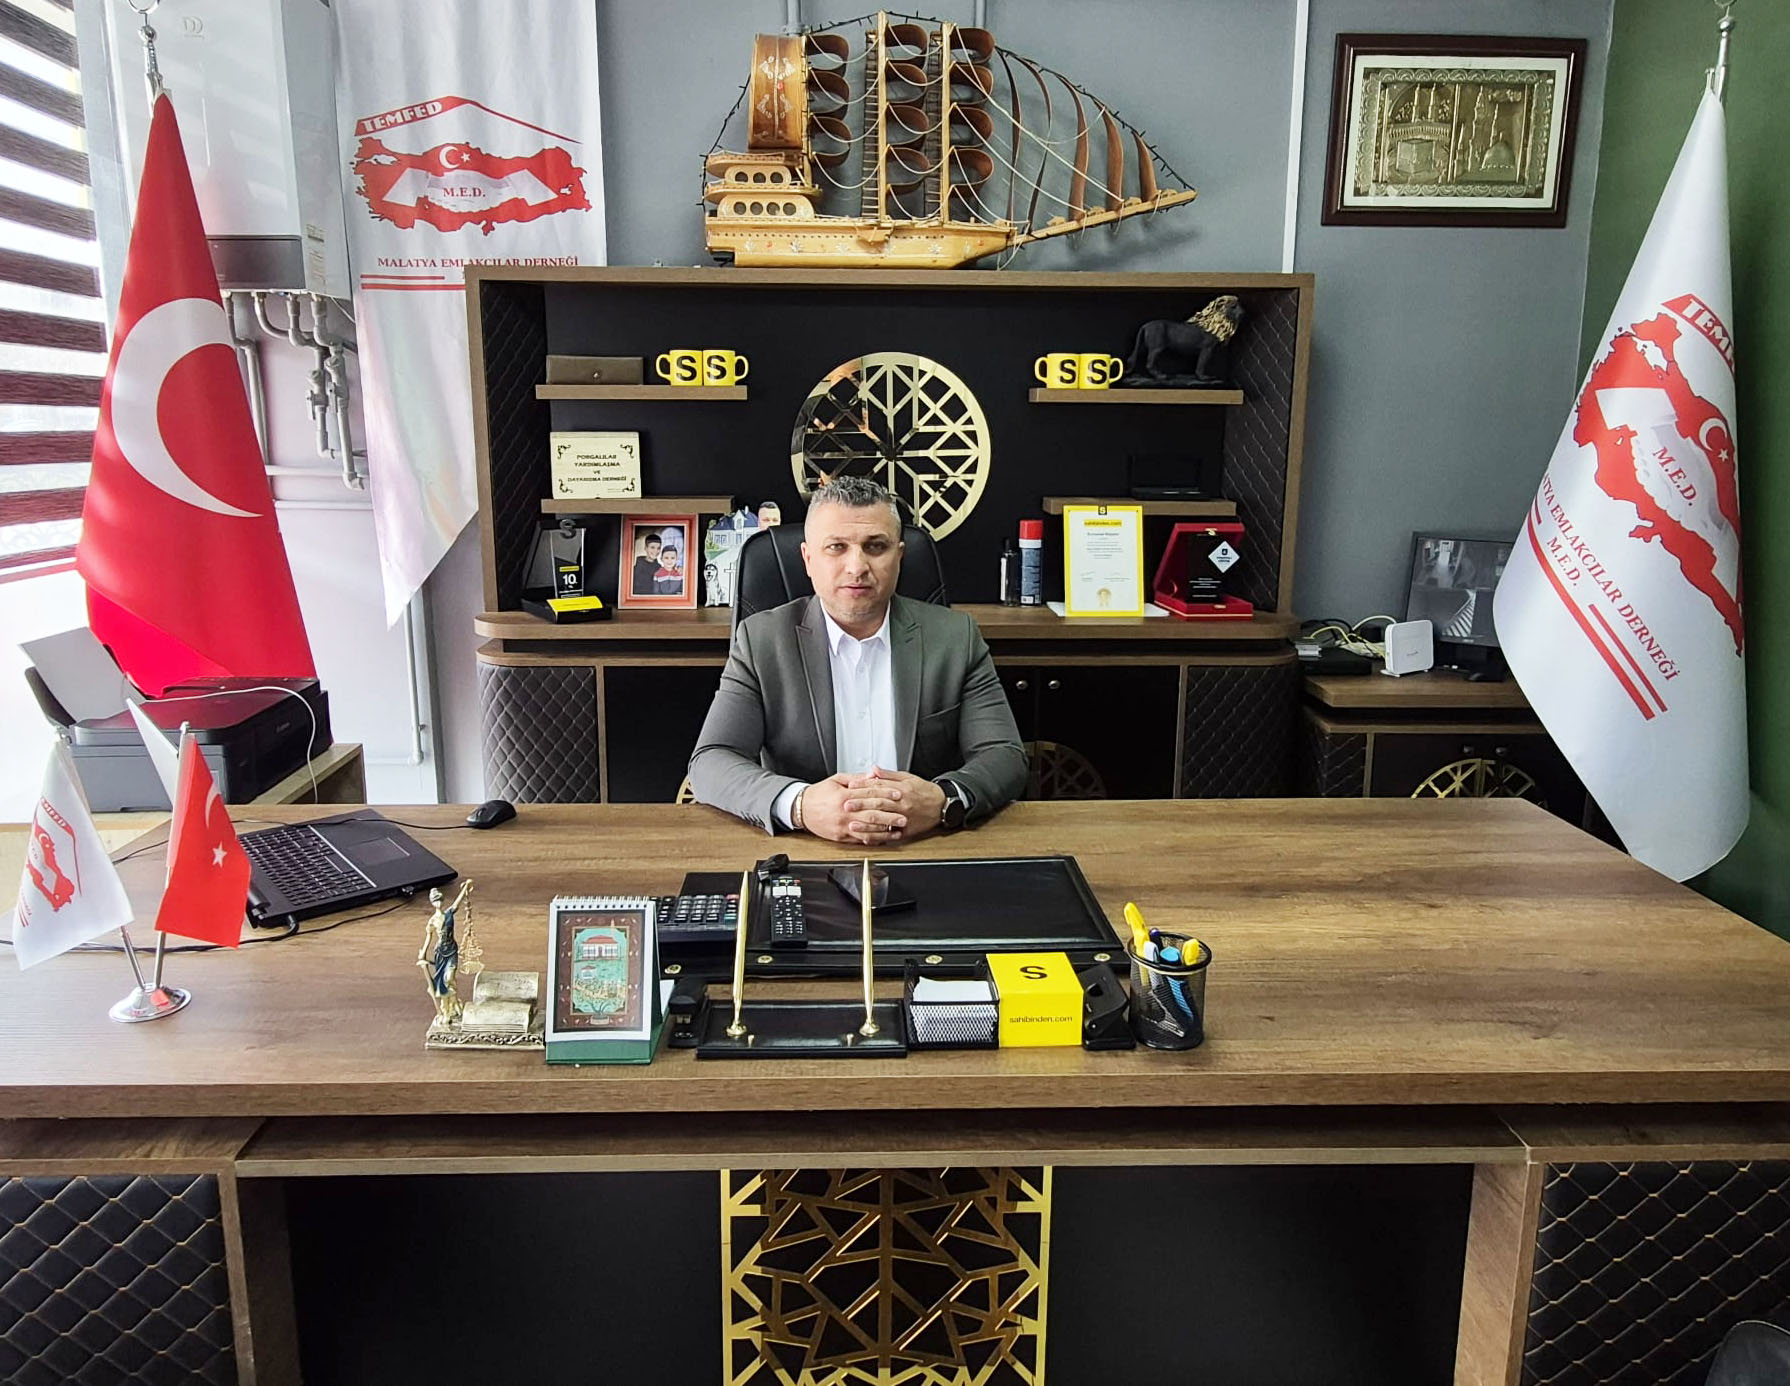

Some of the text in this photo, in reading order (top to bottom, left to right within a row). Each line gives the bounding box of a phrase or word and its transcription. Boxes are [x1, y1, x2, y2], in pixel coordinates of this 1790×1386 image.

[363, 101, 442, 133] TEMFED
[443, 187, 486, 197] M.E.D.
[378, 257, 437, 268] MALATYA
[676, 355, 698, 381] S
[706, 354, 727, 380] S
[1060, 359, 1077, 384] S
[1088, 359, 1107, 384] S
[1652, 446, 1697, 507] M.E.D.
[1547, 537, 1581, 587] M.E.D.
[1550, 504, 1623, 603] EMLAKCILAR
[1617, 603, 1680, 680] DERNEĞİ
[1019, 965, 1048, 980] S
[1009, 1015, 1073, 1023] sahibinden.com
